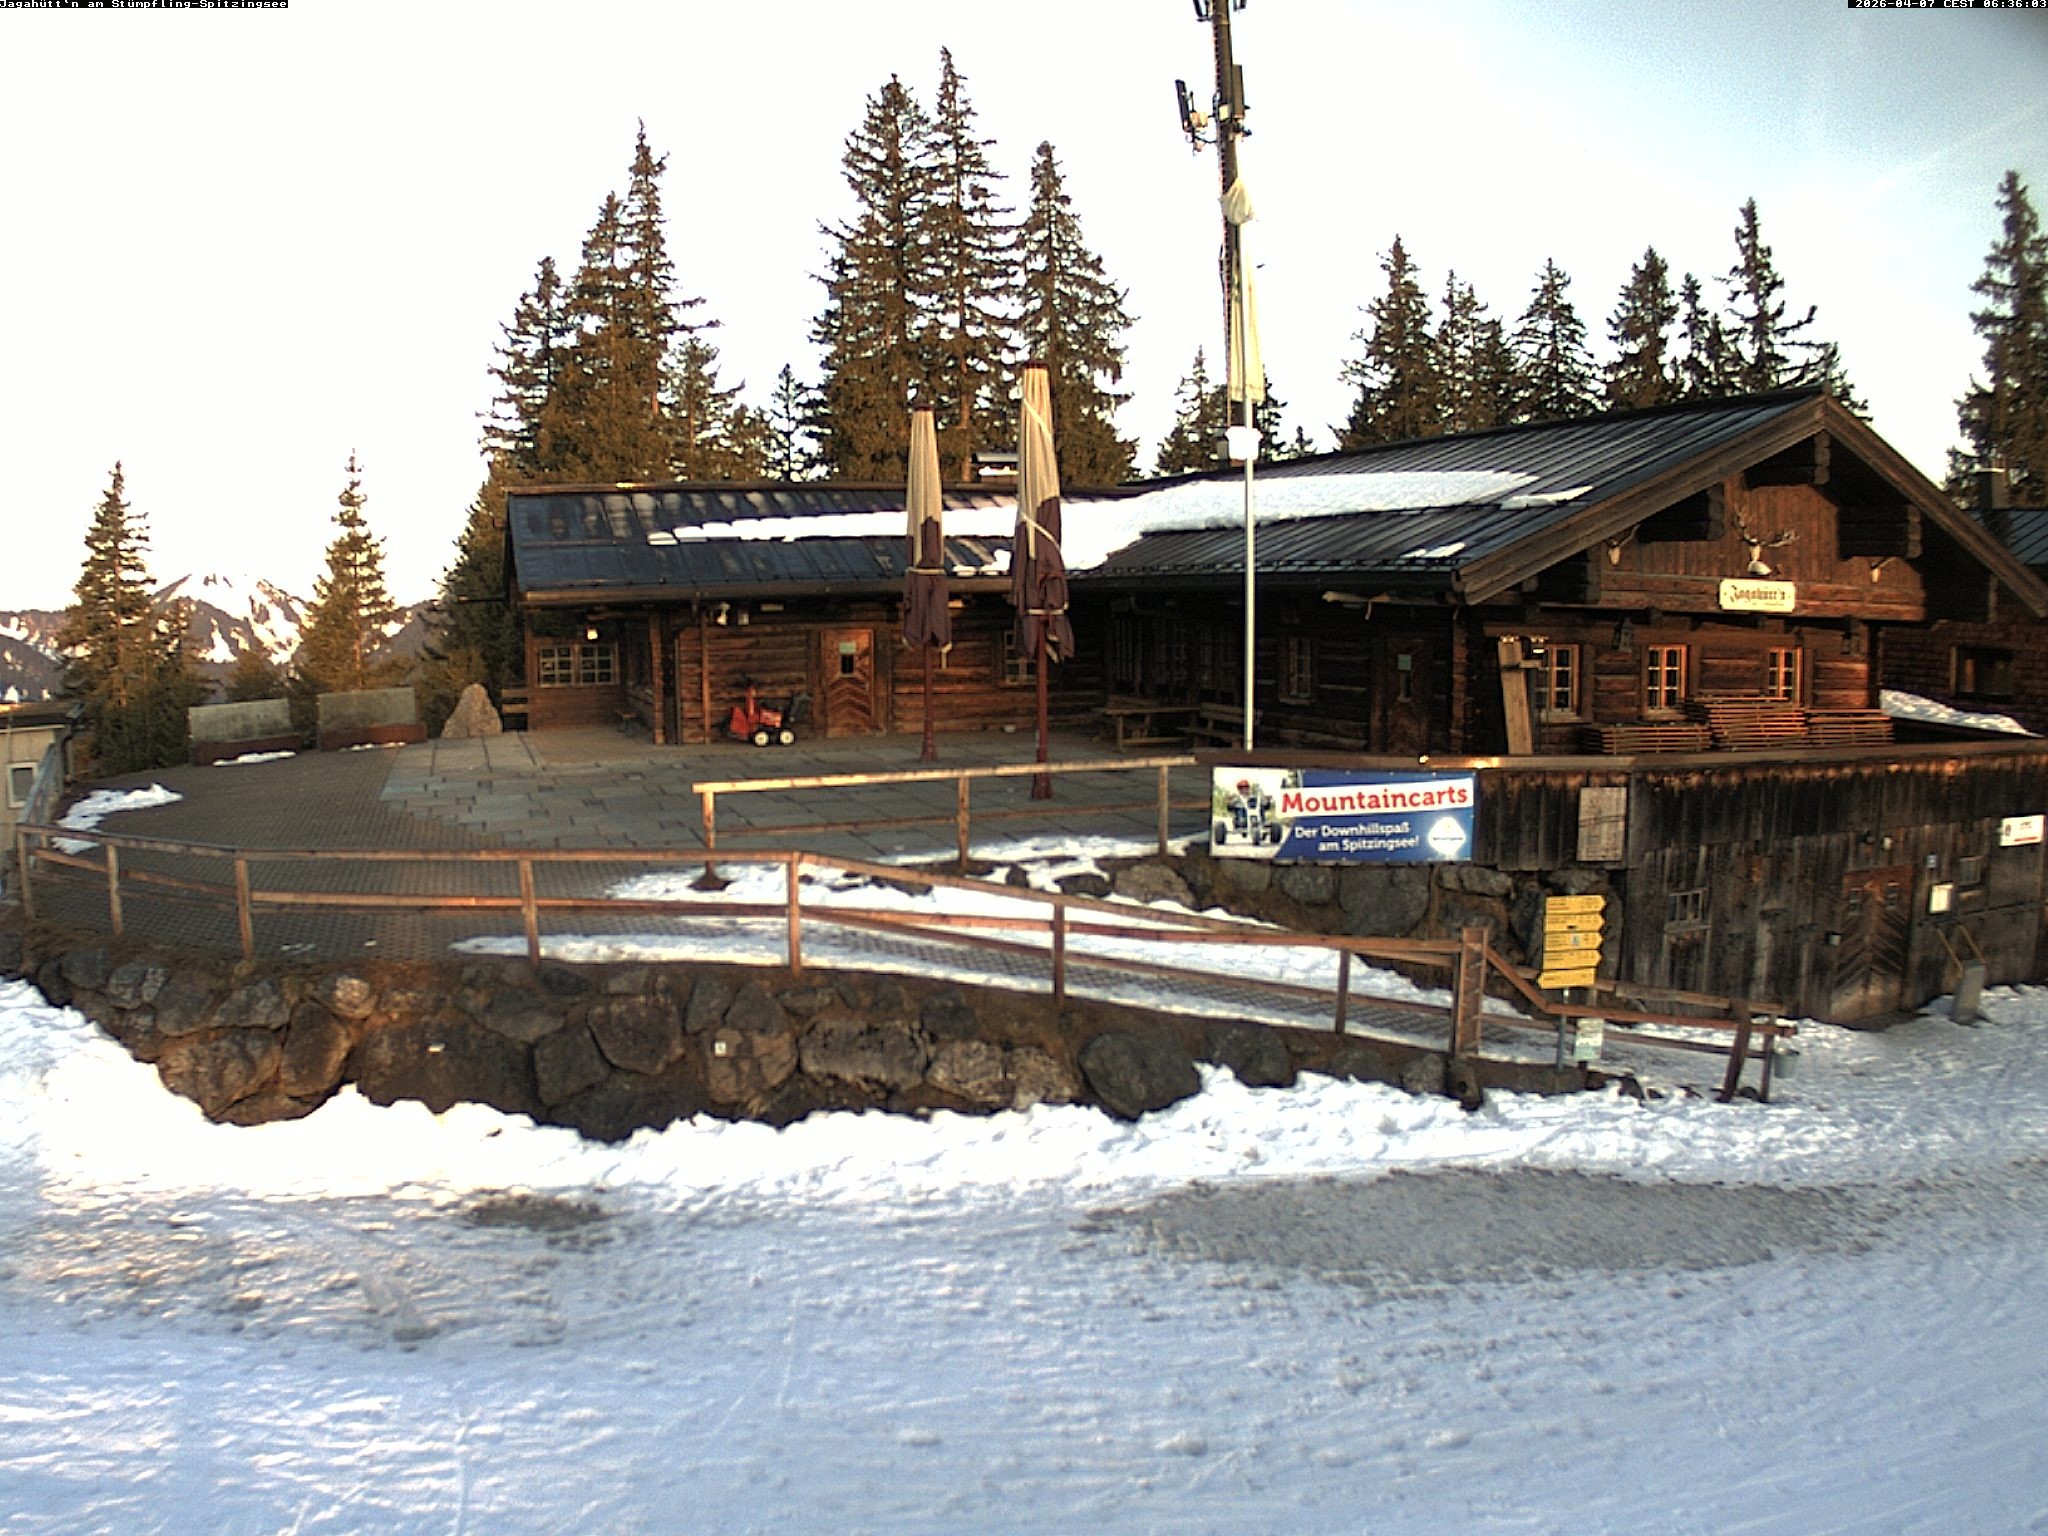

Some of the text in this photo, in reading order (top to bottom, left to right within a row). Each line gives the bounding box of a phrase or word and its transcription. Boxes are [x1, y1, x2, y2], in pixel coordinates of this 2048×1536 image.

[1281, 787, 1468, 813] Mountaincarts
[1295, 821, 1410, 838] Der Downhillspaß
[1317, 836, 1420, 852] am Spitzingsee!
